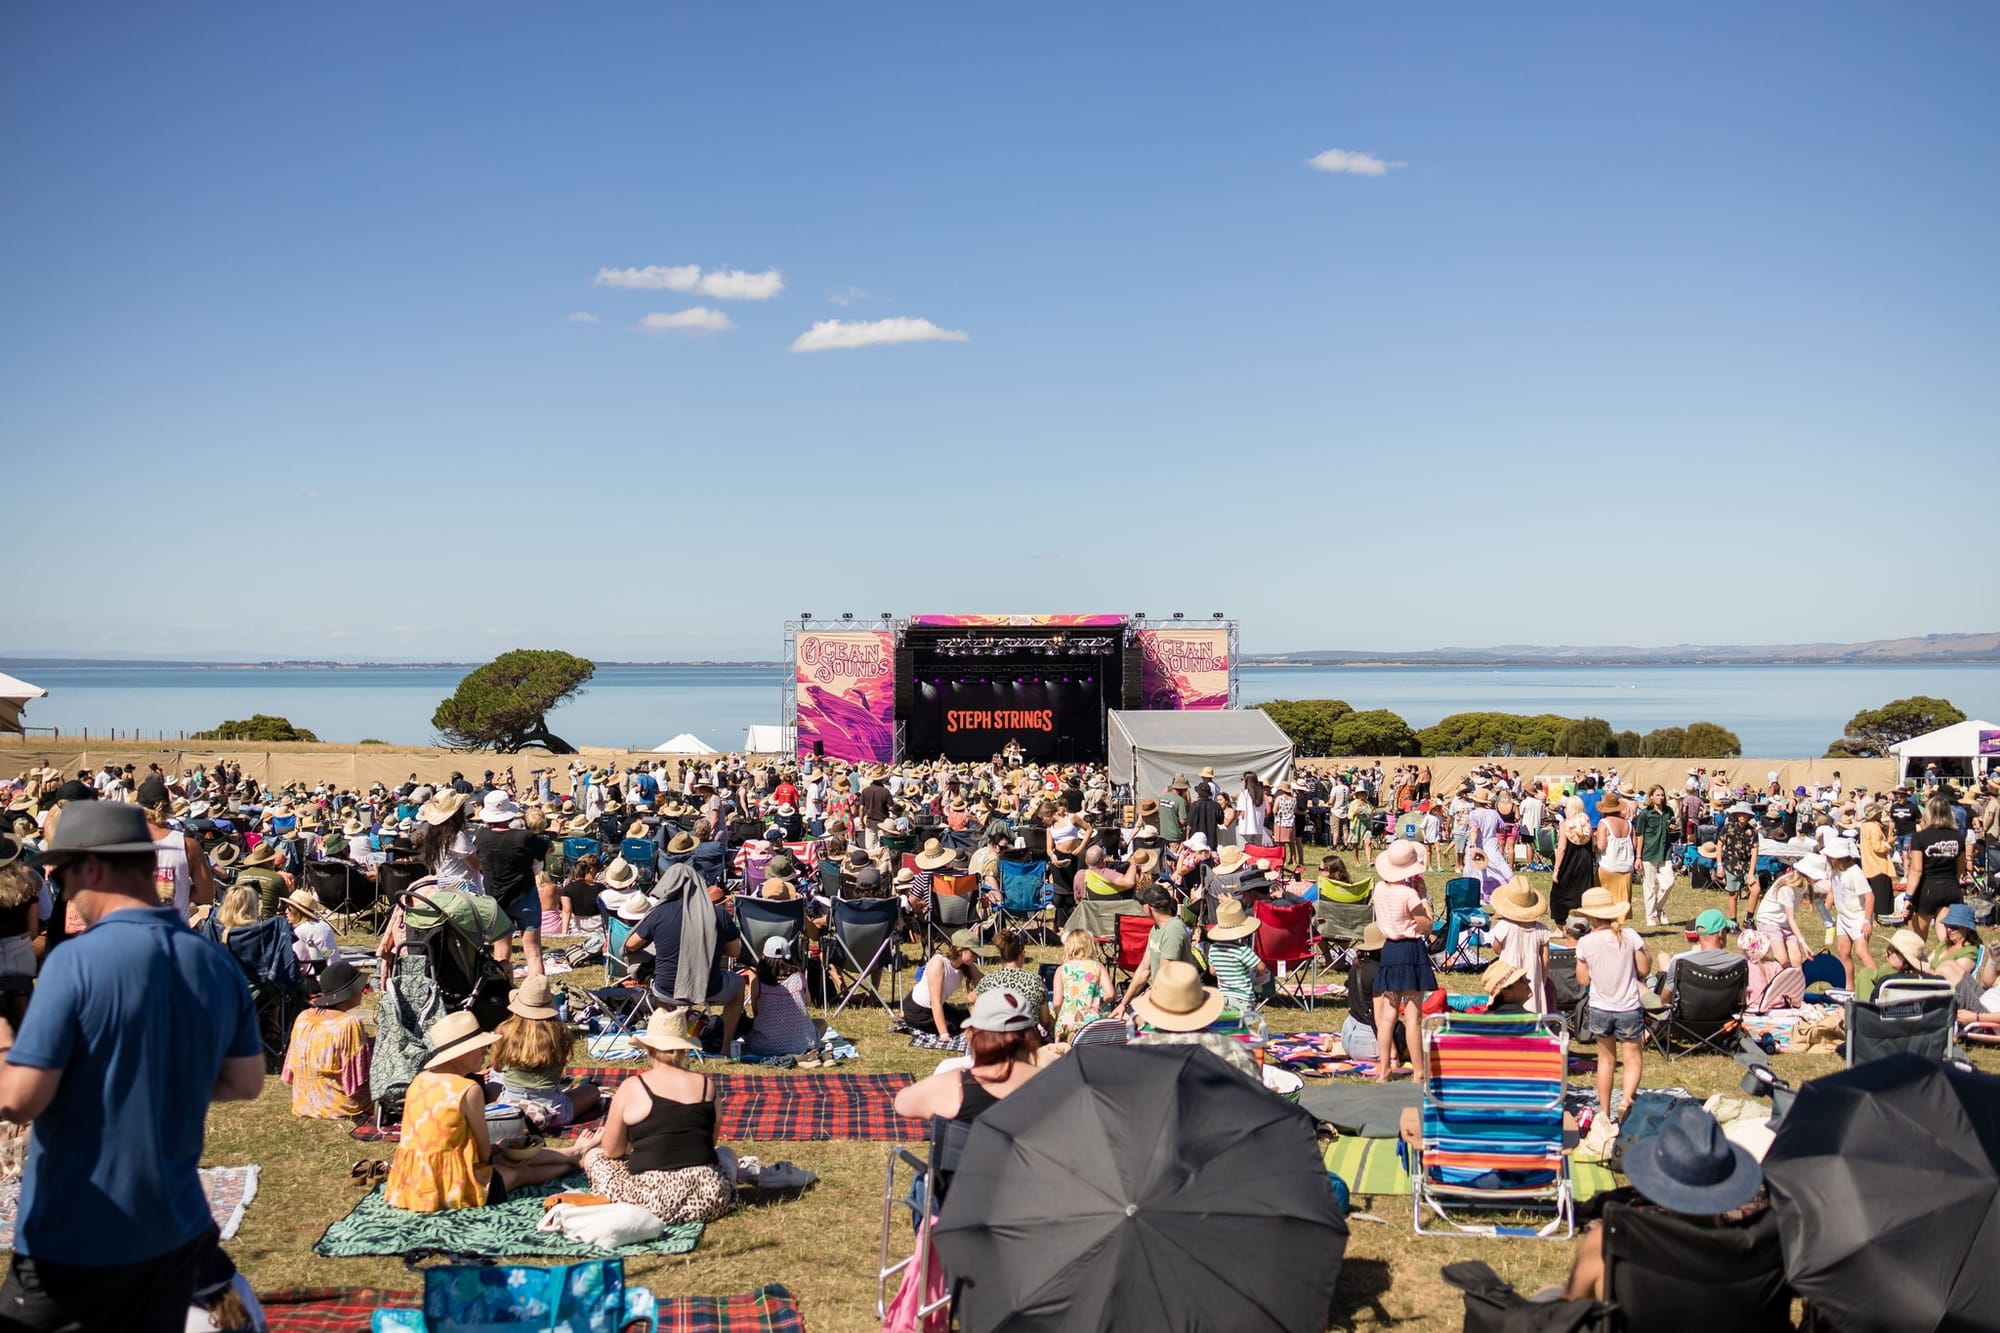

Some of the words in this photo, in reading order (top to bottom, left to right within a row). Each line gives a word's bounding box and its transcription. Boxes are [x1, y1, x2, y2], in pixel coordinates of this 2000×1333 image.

[800, 636, 880, 666] OCEAN
[1144, 634, 1214, 662] OCEAN
[814, 655, 889, 684] SOUNDS
[1155, 651, 1222, 679] SOUNDS
[947, 710, 991, 732] STEPH
[993, 710, 1053, 732] STRINGS
